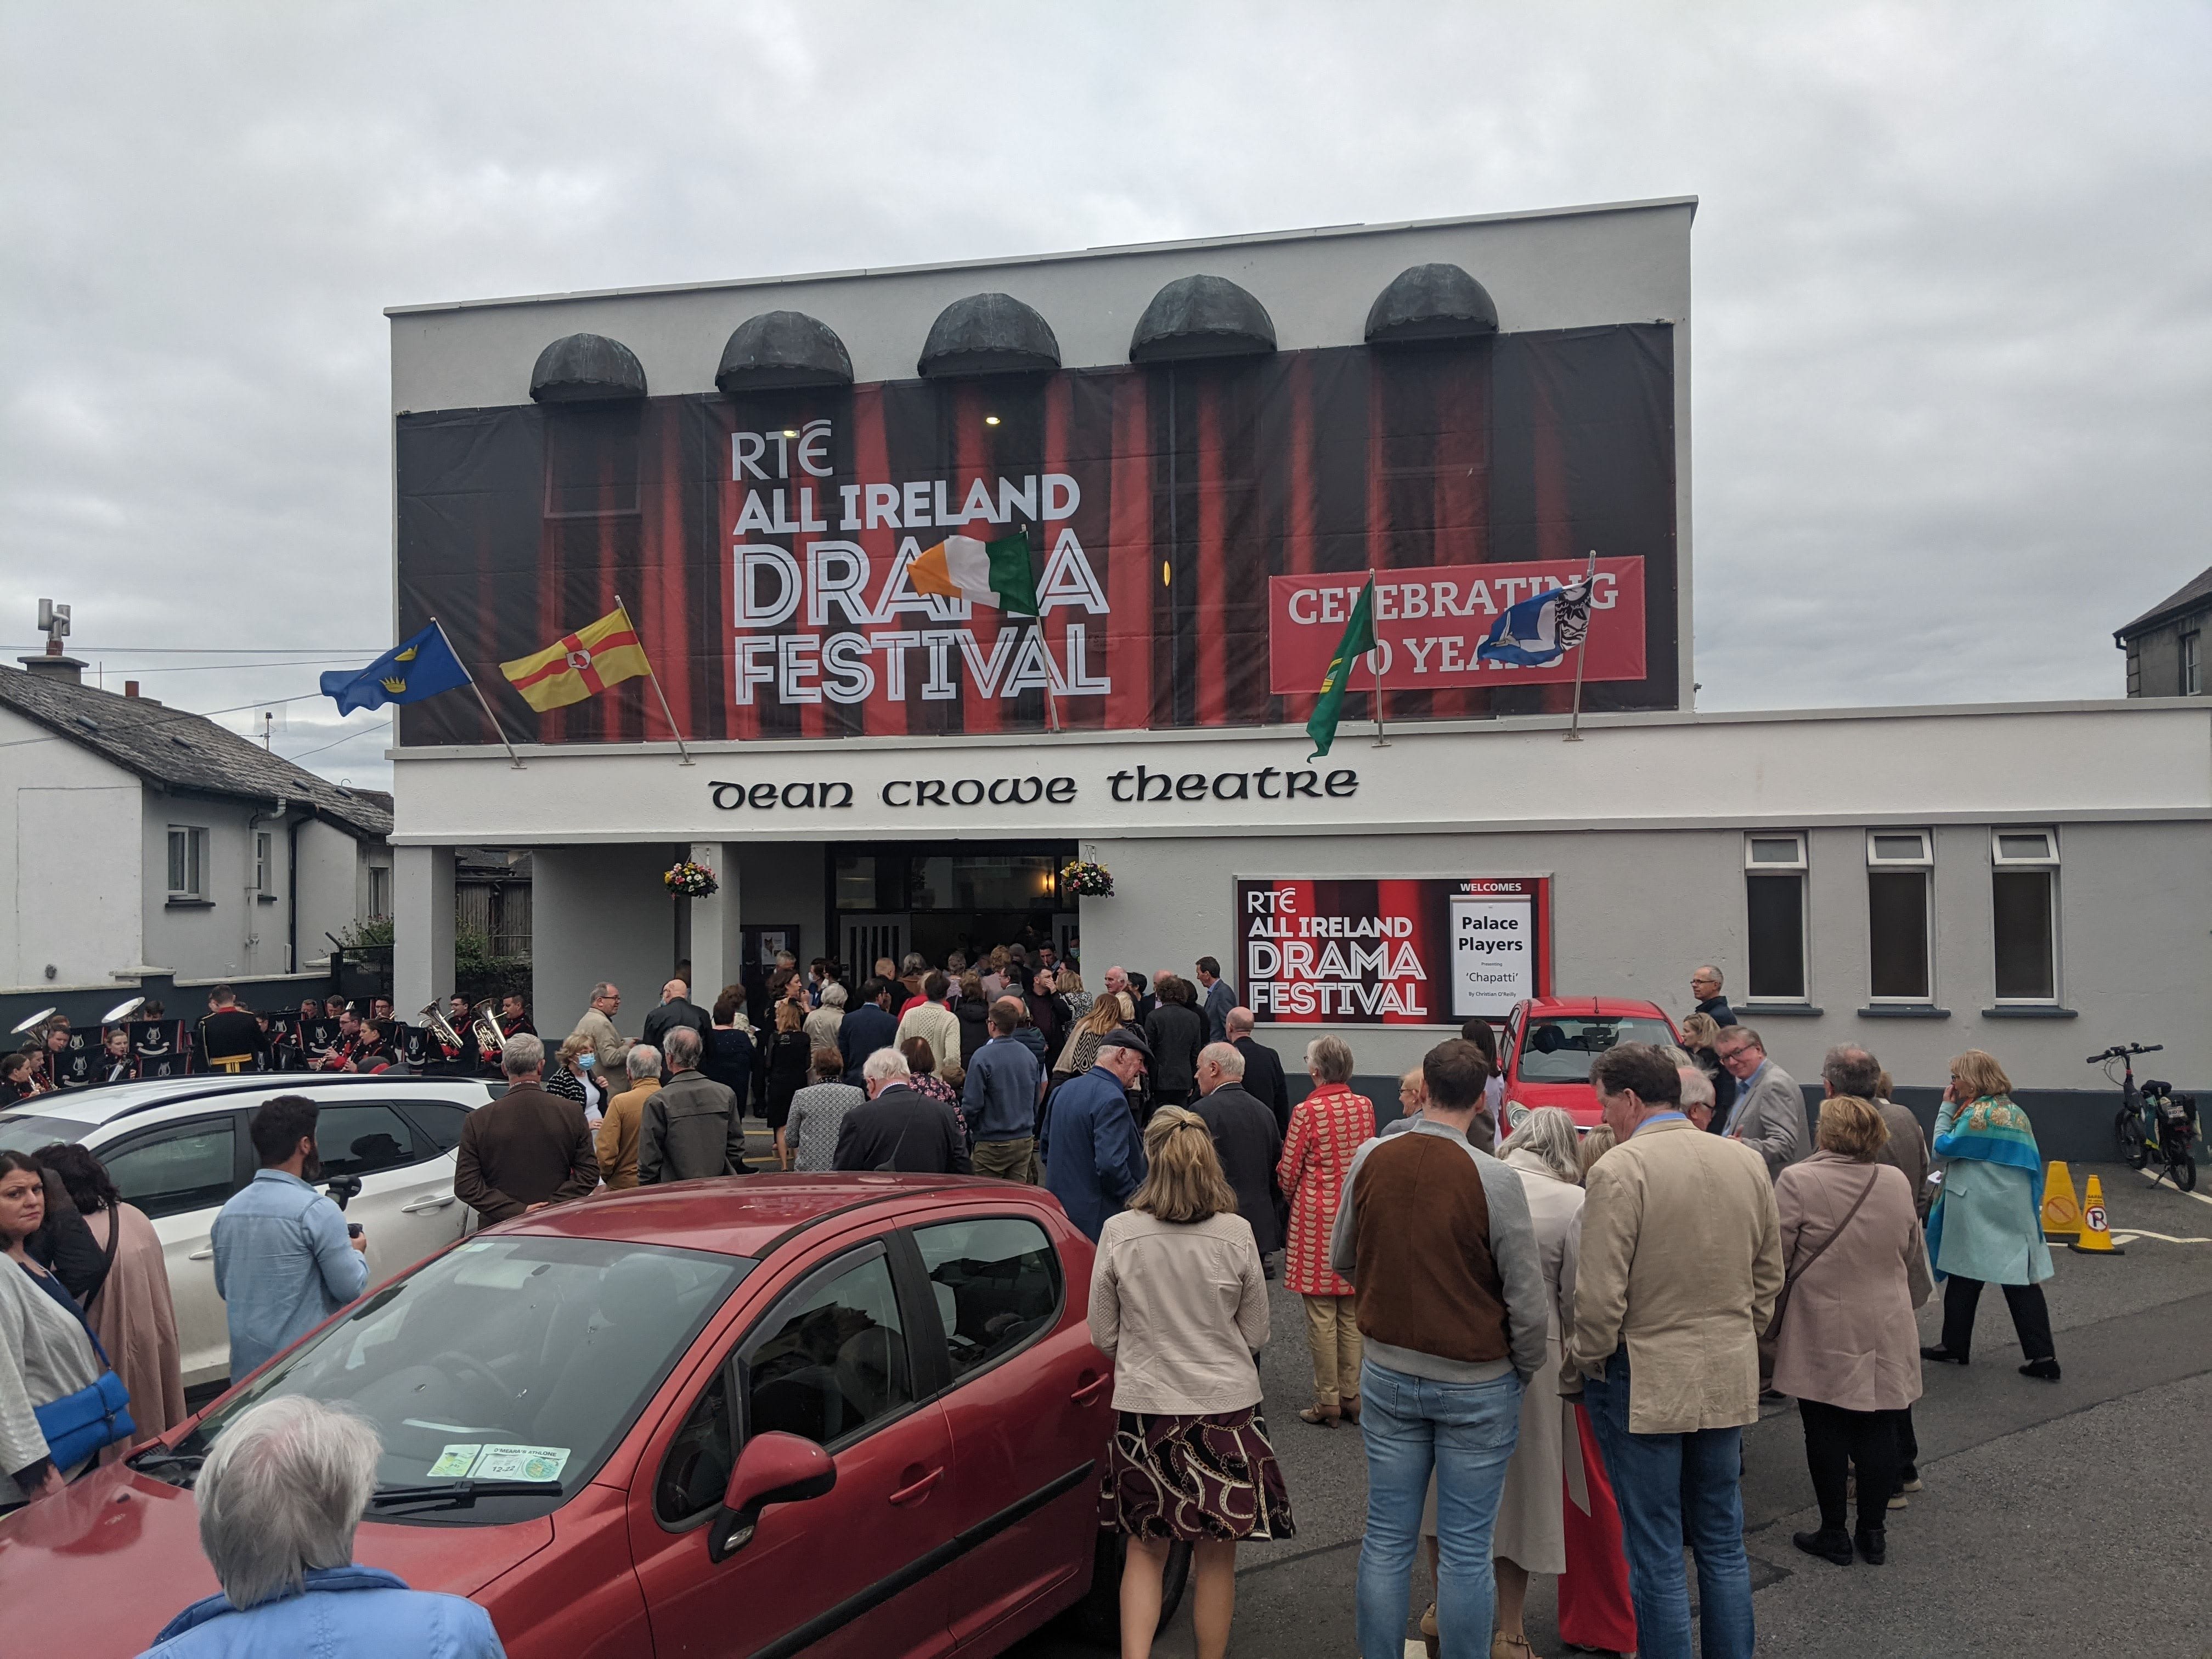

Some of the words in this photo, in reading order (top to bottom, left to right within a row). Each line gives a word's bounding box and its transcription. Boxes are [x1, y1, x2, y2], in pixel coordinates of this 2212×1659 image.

[733, 487, 828, 535] ALL
[839, 473, 1081, 531] IRELAND
[733, 528, 1110, 628] DRAA
[735, 623, 1111, 706] FESTIVAL
[1460, 883, 1522, 892] WELCOMES
[1248, 917, 1294, 938] ALL
[1299, 916, 1413, 938] IRELAND
[1462, 916, 1519, 930] Palace
[1459, 937, 1523, 955] Players
[1249, 941, 1427, 980] DRAMA
[1250, 982, 1427, 1015] FESTIVAL
[2092, 1211, 2104, 1227] P
